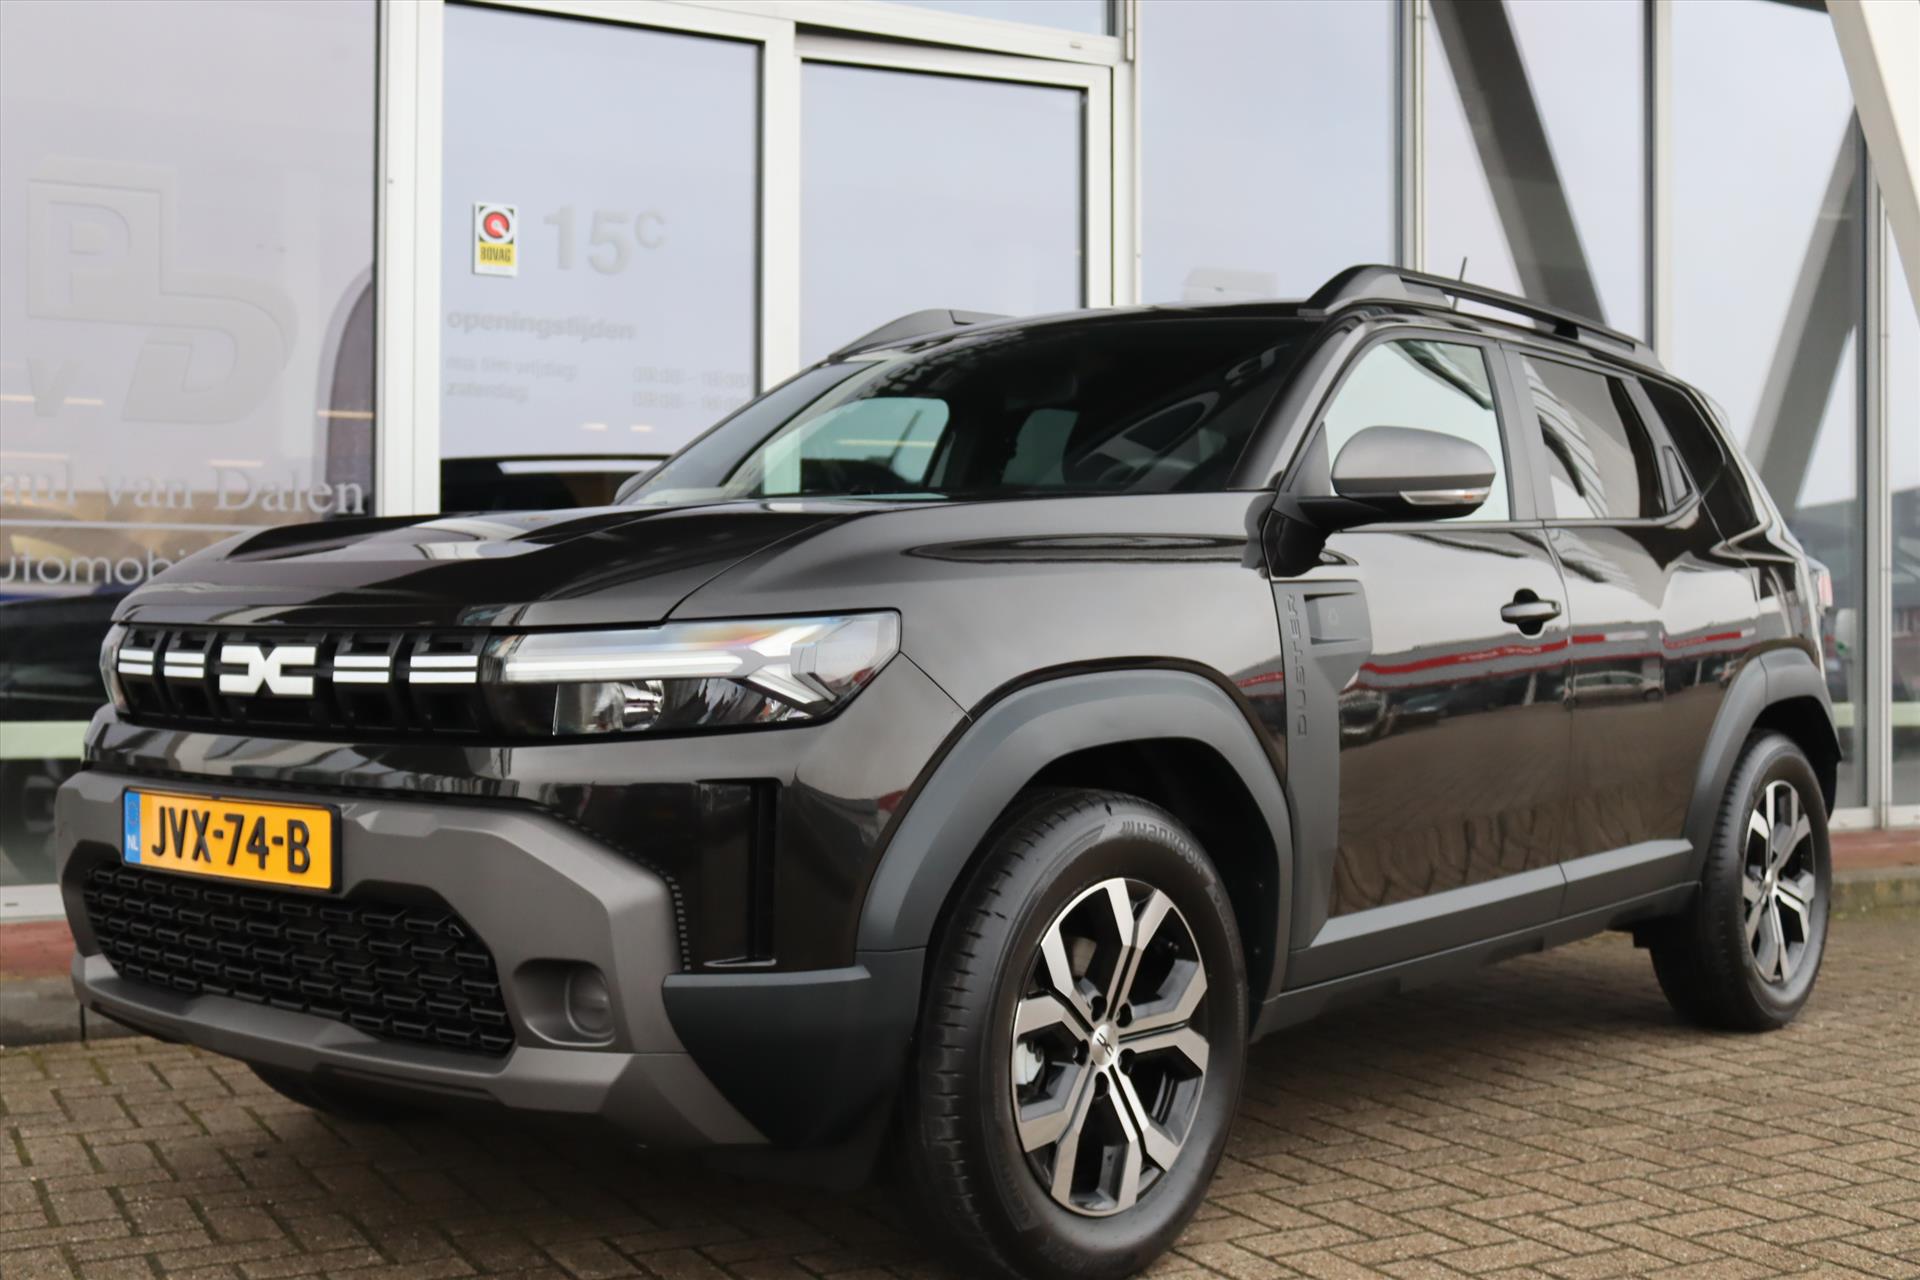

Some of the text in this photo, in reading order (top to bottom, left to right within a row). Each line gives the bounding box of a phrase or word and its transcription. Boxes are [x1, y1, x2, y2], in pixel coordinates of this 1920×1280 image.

[480, 246, 512, 263] BOVAG
[447, 310, 636, 342] openingstijden
[100, 475, 193, 509] van
[213, 464, 363, 514] Dalen
[1287, 593, 1307, 736] DUSTER
[127, 834, 138, 851] NL
[152, 806, 310, 874] JVX-74-B
